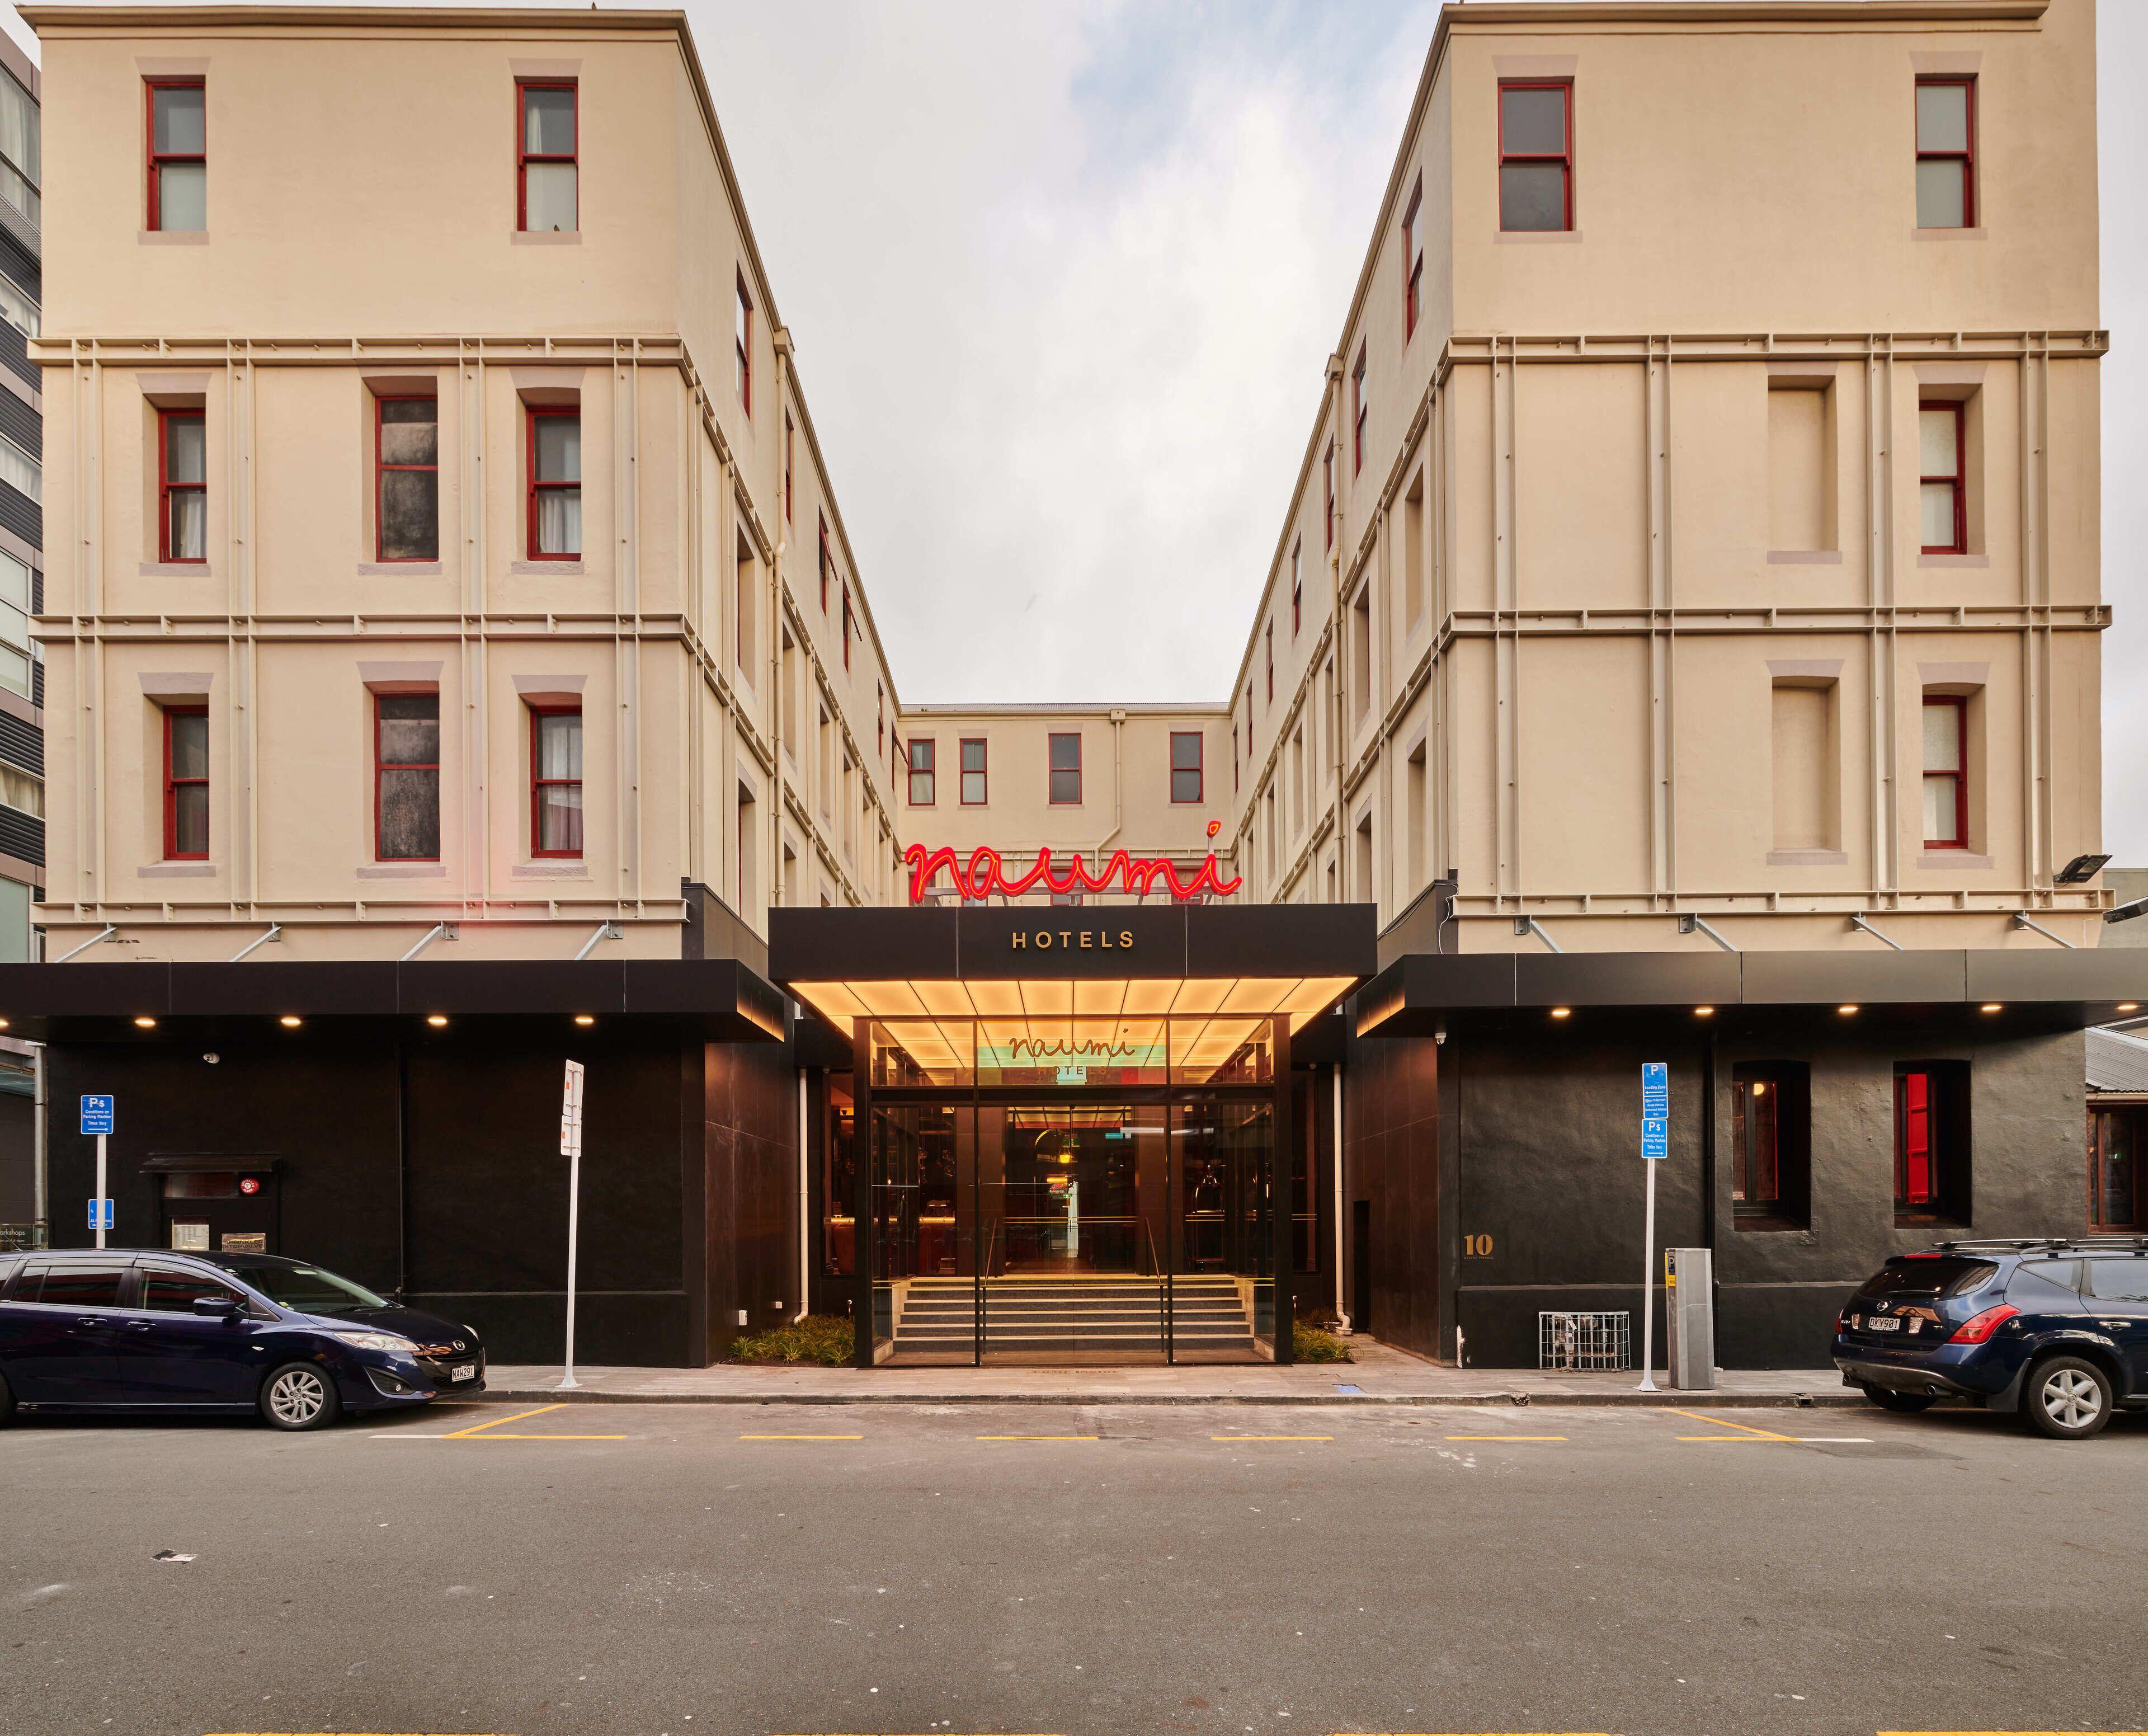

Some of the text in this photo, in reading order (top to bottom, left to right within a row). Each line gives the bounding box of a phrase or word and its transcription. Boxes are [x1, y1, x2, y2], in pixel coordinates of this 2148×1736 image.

[905, 820, 1242, 904] naumi
[1012, 931, 1133, 948] HOTELS
[1009, 1028, 1136, 1060] naumi
[1038, 1066, 1108, 1075] HOTELS
[1651, 1065, 1659, 1075] P
[1463, 1234, 1494, 1255] 10
[1869, 1318, 1898, 1329] DKY901
[453, 1367, 473, 1379] NAW291
